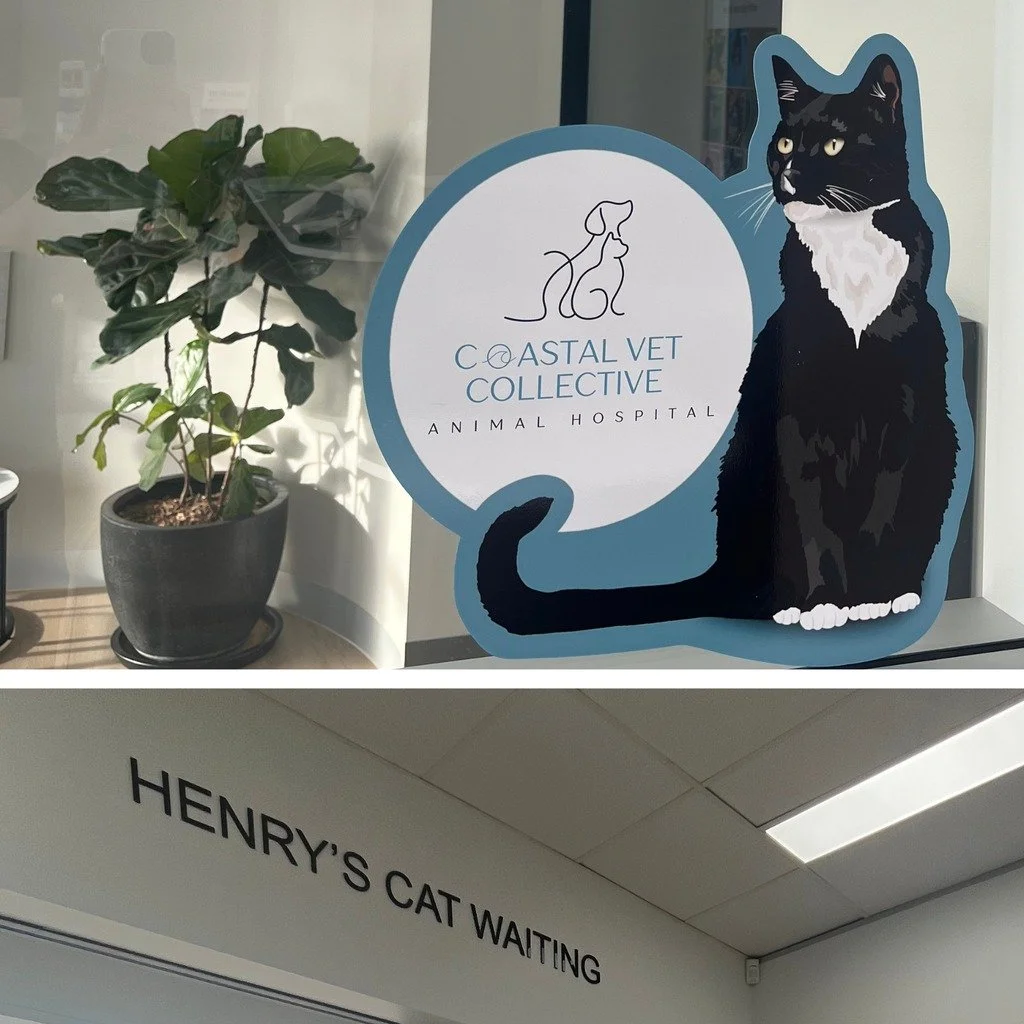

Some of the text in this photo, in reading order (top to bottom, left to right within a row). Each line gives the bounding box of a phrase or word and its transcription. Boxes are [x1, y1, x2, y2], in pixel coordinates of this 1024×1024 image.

[454, 335, 683, 369] COASTAL VET
[466, 369, 663, 403] COLLECTIVE
[428, 405, 715, 435] ANIMAL HOSPITAL
[129, 757, 602, 985] HENRY'S CAT WAITING
